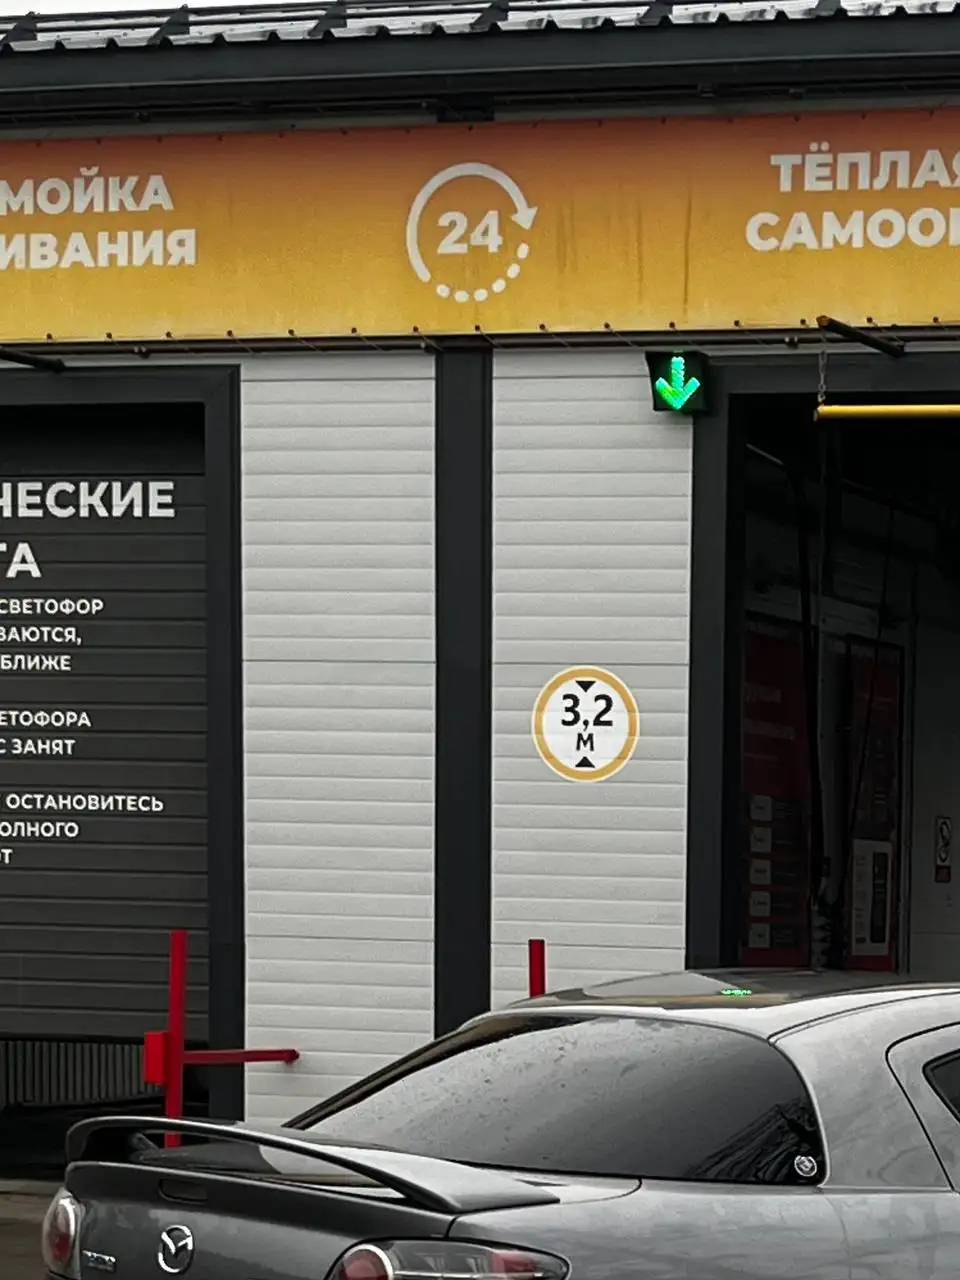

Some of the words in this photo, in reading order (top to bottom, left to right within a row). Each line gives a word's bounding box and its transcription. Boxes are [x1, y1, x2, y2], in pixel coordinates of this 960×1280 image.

[437, 211, 503, 254] 24
[0, 654, 71, 671] БЛИЖЕ
[561, 693, 614, 732] 3,2
[11, 738, 76, 755] ЗАНЯТ
[5, 793, 164, 811] ОСТАНОВИТЕСЬ
